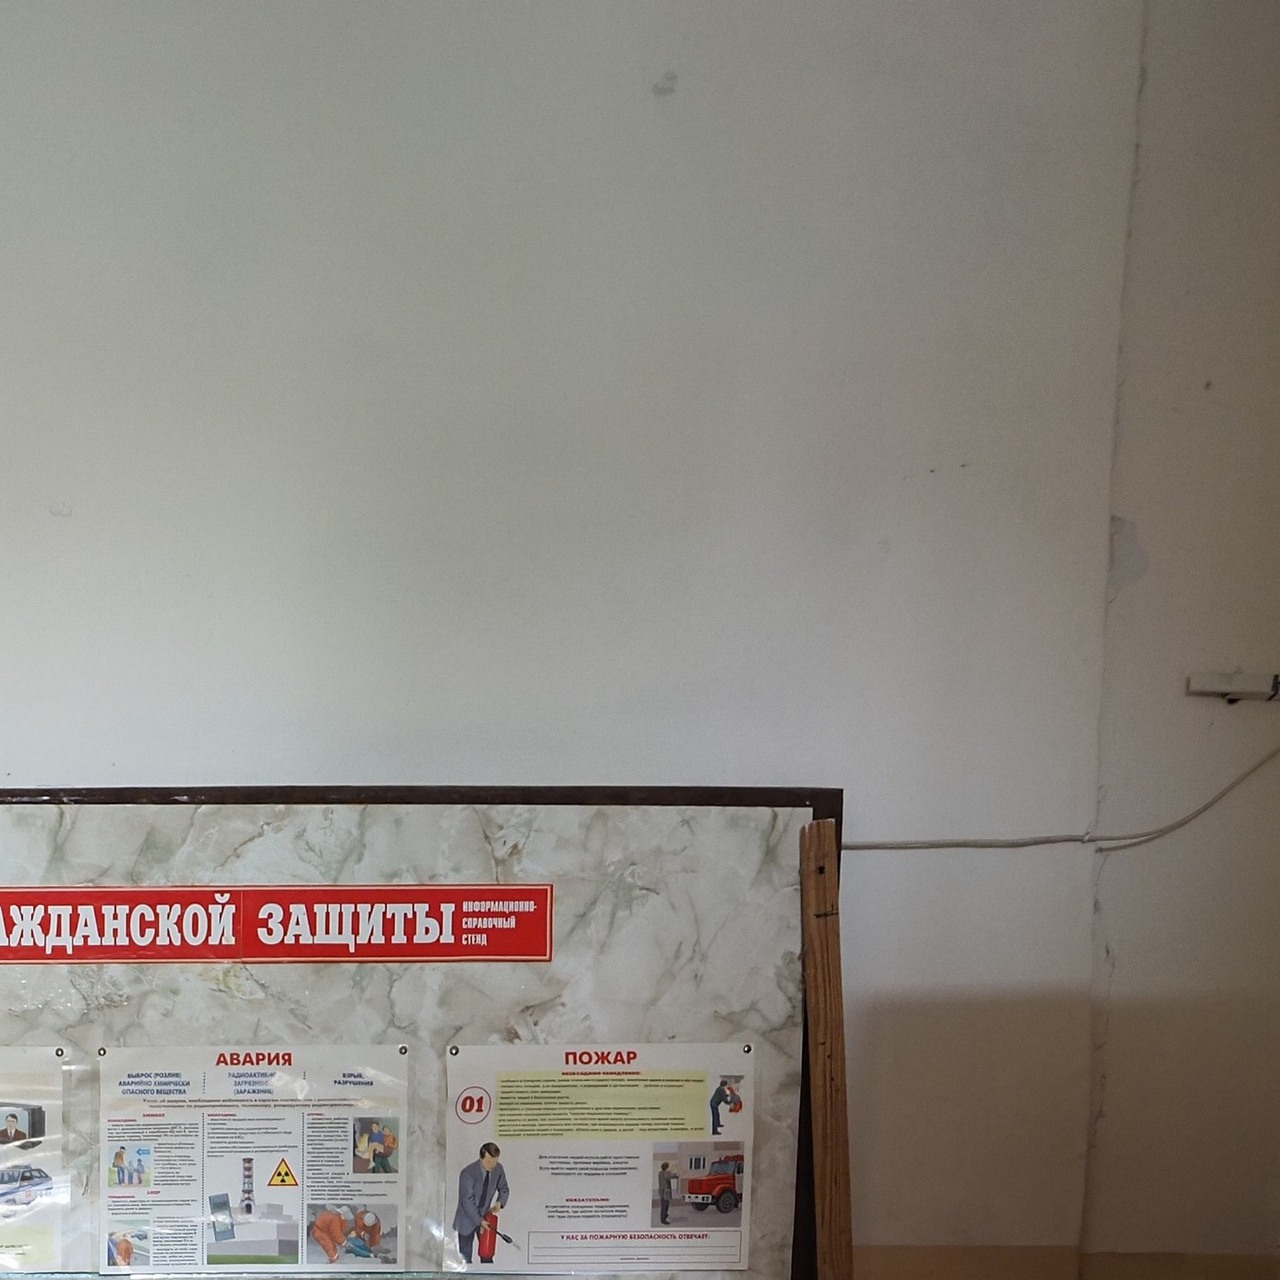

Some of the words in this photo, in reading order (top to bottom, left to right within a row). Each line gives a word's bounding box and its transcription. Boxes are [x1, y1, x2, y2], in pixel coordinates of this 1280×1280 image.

[462, 901, 537, 913] ИНФОРМАЦИОННО-
[257, 903, 455, 954] ЗАЩИТЫ
[462, 916, 516, 929] СПРАВОЧНЫЙ
[462, 934, 487, 946] СТЕНД
[215, 1052, 293, 1066] АВАРИЯ
[564, 1051, 638, 1066] ПОЖАР
[461, 1096, 484, 1113] 01
